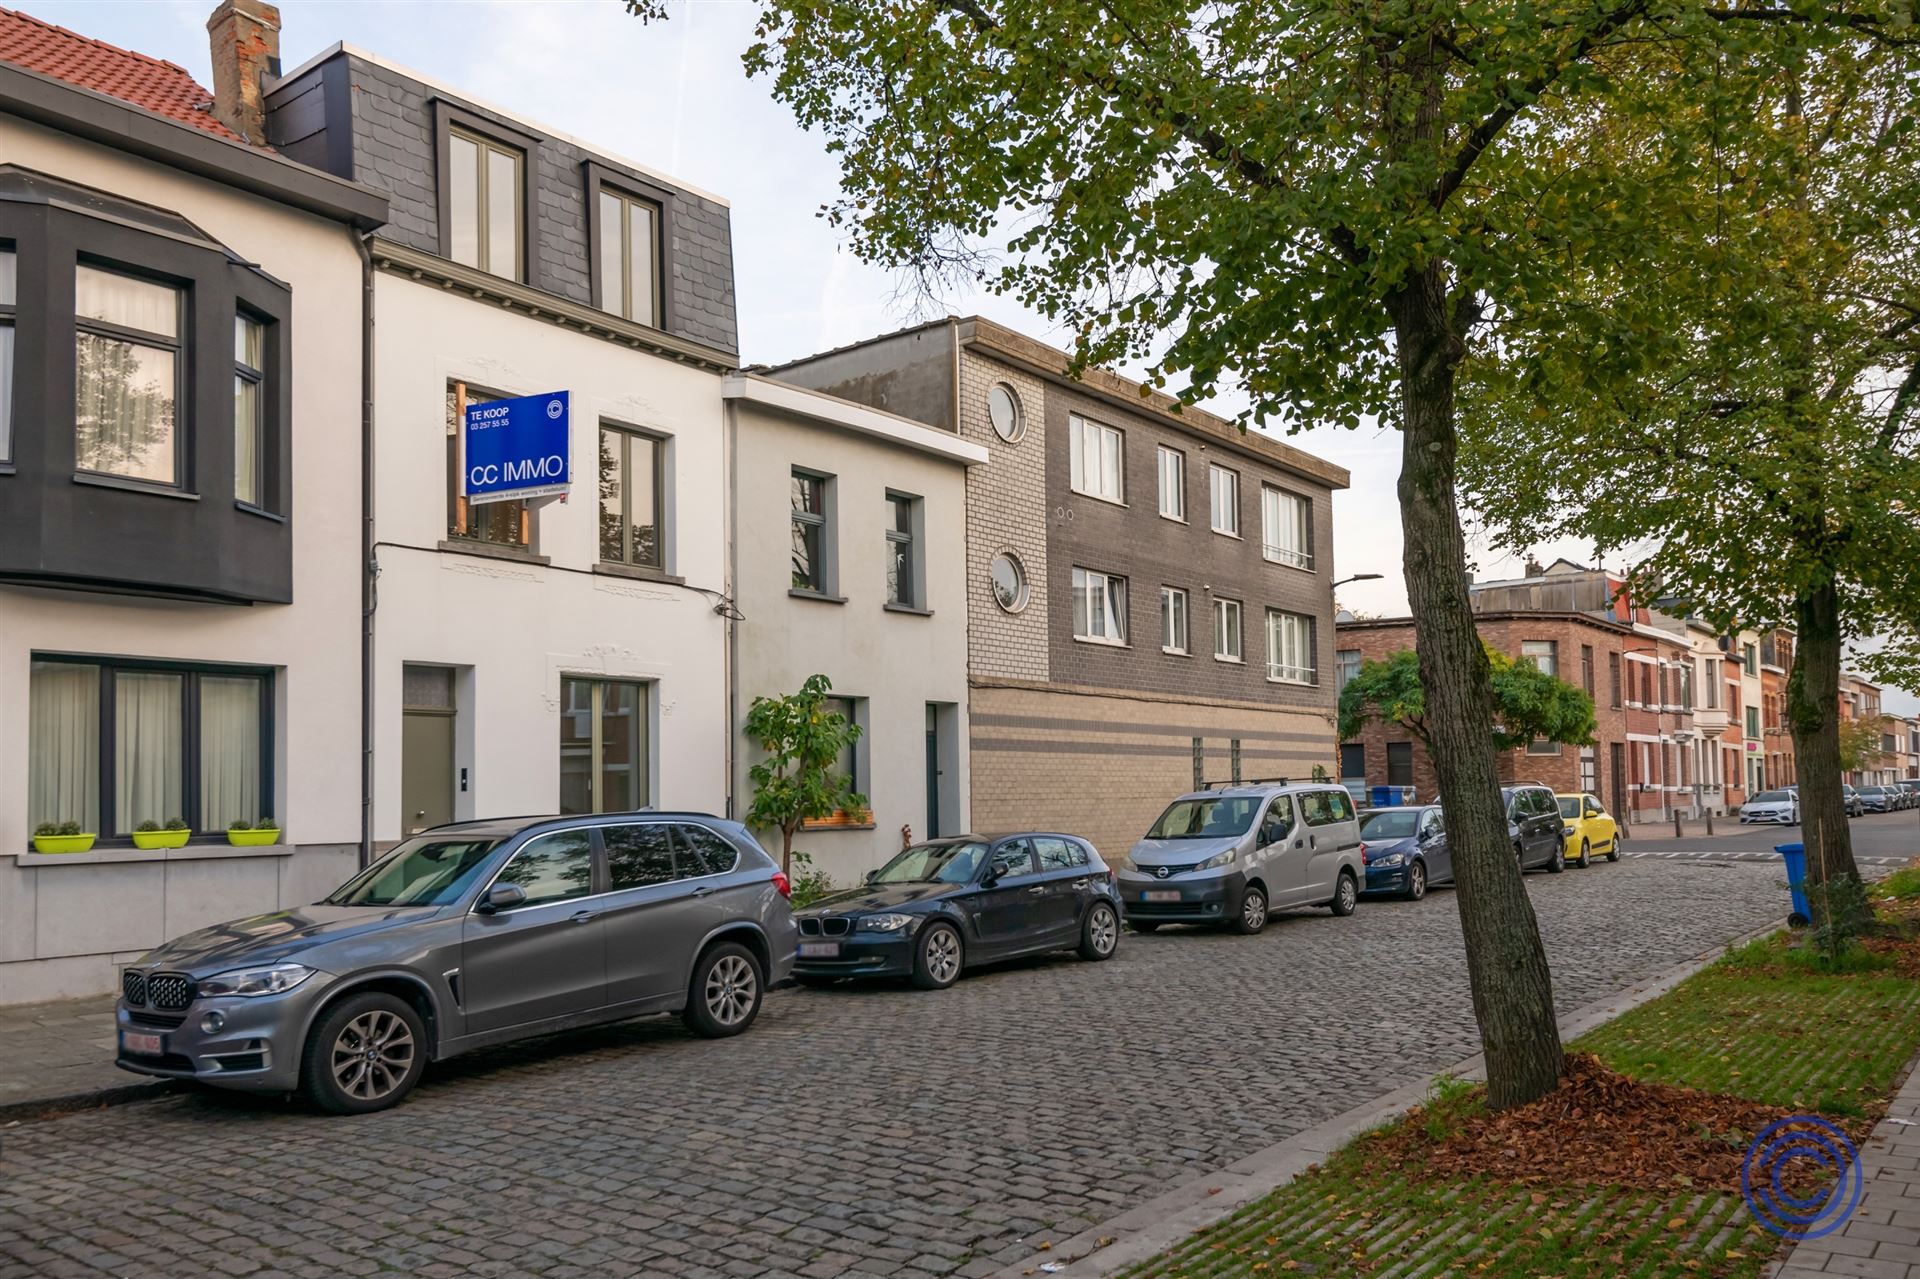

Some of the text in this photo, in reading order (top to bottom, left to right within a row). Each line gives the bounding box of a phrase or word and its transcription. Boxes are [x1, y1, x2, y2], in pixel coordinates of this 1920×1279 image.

[471, 407, 509, 420] TE KOOP
[480, 421, 490, 429] 257
[471, 455, 563, 486] CC IMMO
